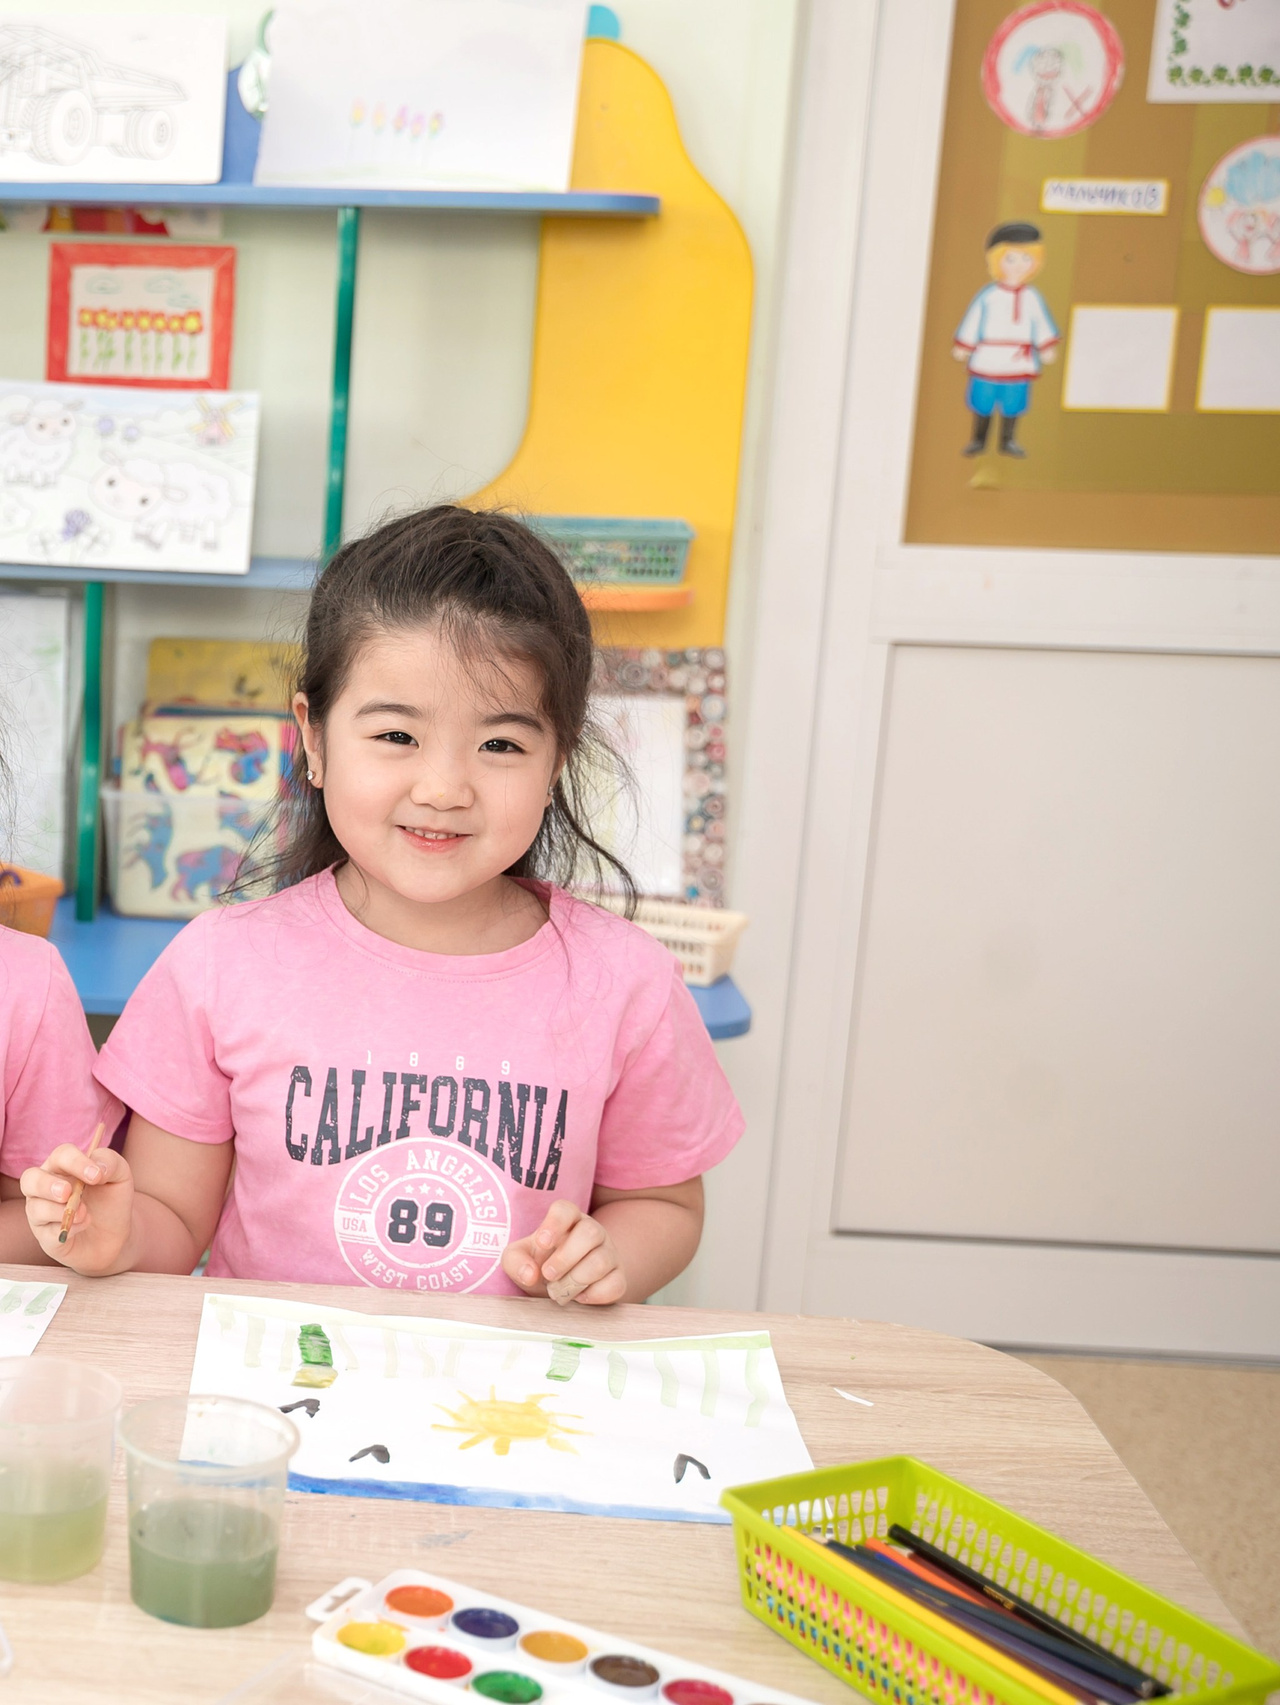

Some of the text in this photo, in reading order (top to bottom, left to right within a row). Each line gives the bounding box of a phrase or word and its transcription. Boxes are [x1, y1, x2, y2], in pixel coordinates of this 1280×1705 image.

[285, 1065, 569, 1191] CALIFORNIA
[349, 1148, 498, 1220] LOS ANGELES
[342, 1216, 367, 1233] USA
[385, 1198, 456, 1249] 89
[473, 1231, 500, 1248] USA
[358, 1248, 475, 1291] WEST COAST
